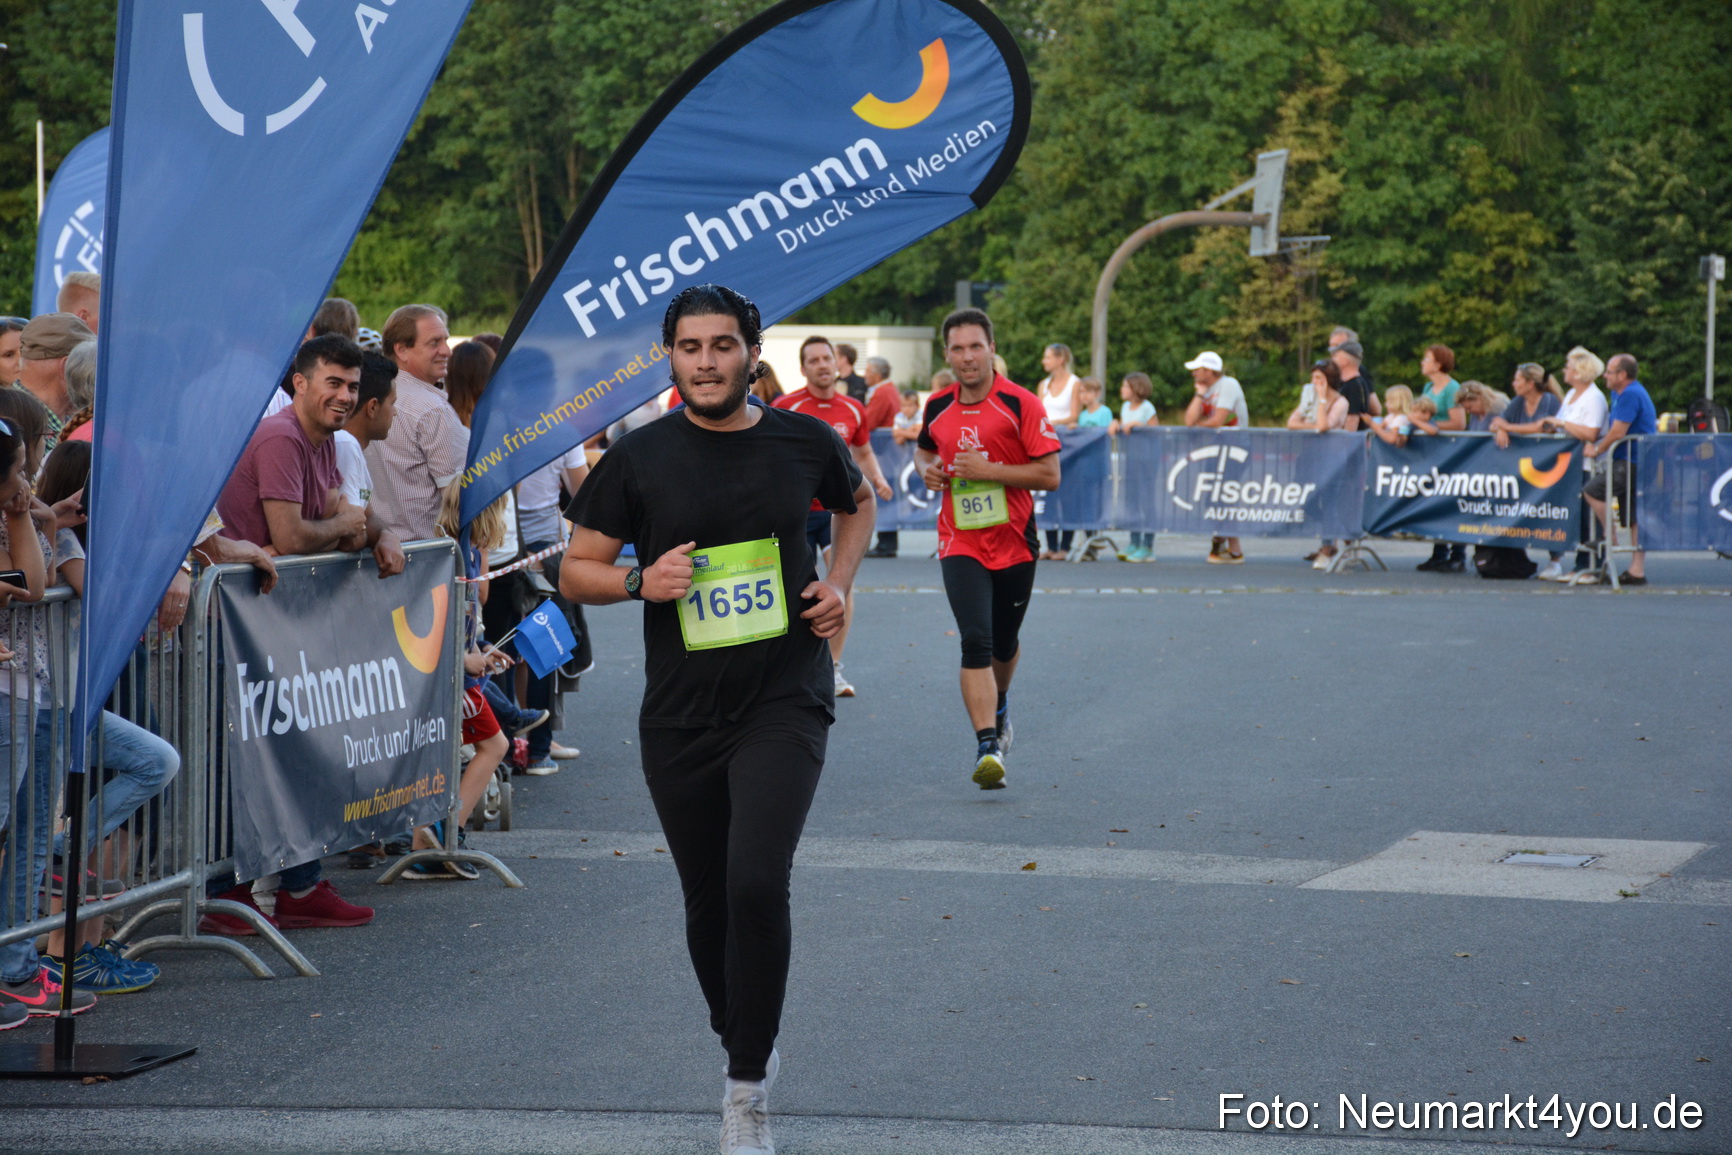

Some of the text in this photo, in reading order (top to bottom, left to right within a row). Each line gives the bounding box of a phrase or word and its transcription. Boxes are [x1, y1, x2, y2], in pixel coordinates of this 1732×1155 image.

[775, 119, 998, 254] Druck und Medien
[562, 137, 888, 338] Frischmann
[1193, 472, 1317, 505] Fischer
[1375, 465, 1520, 500] Frischmann
[961, 494, 994, 515] 961
[1203, 506, 1305, 523] AUTOMOBILE
[1457, 499, 1569, 520] Druck und Medien
[688, 578, 775, 621] 1655
[236, 650, 406, 741] Frischmann
[343, 726, 382, 769] Druck
[384, 719, 410, 758] und
